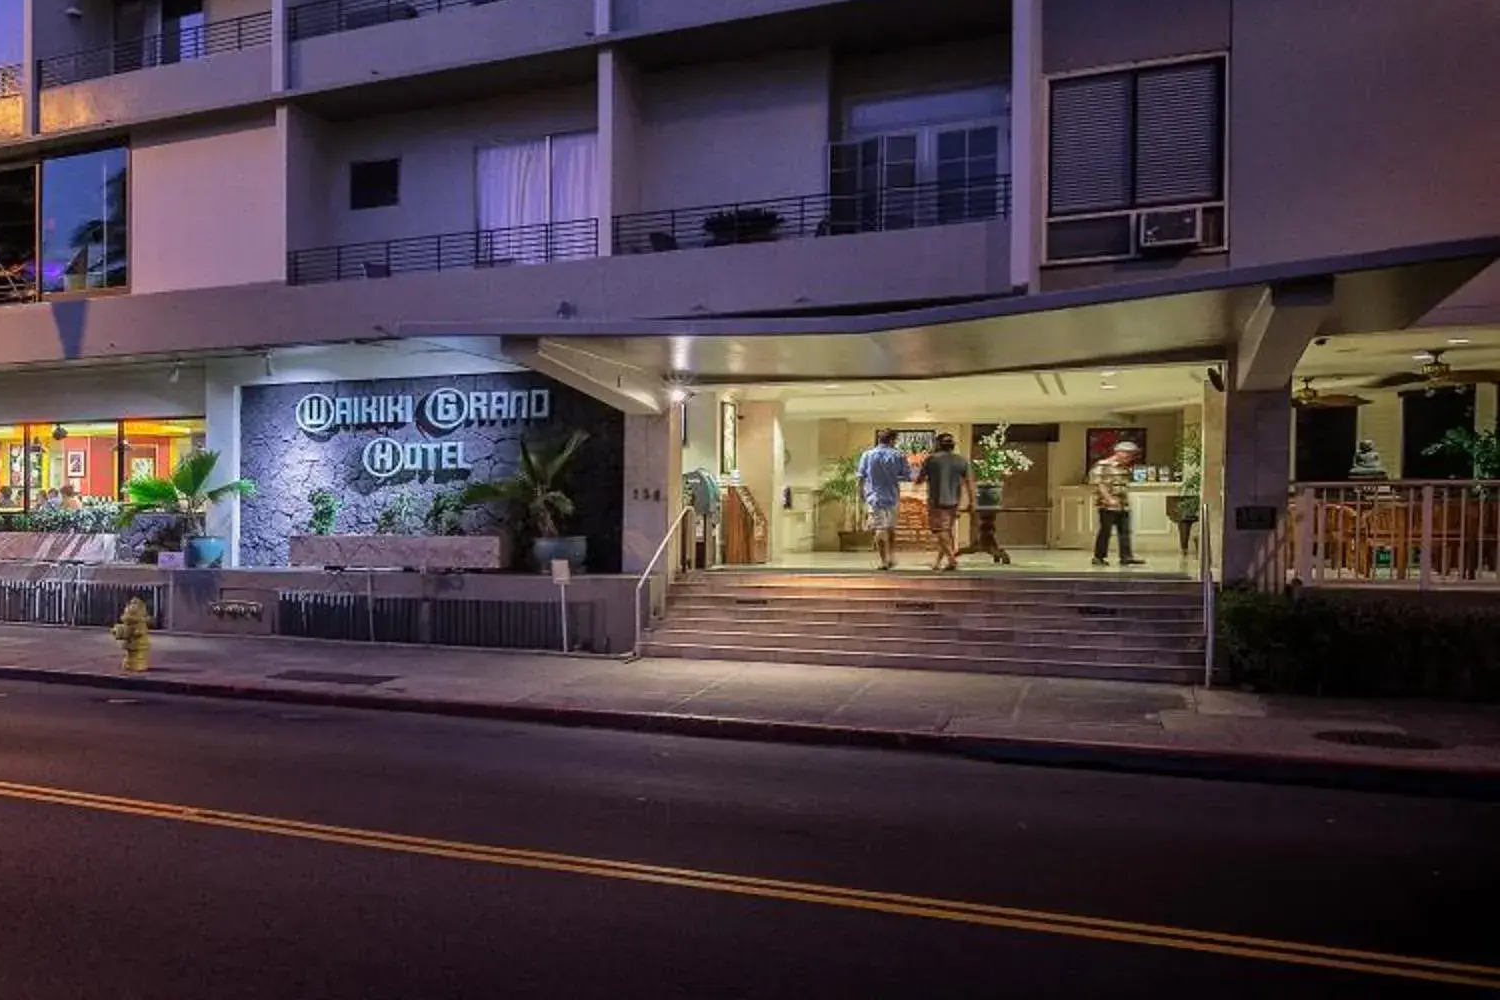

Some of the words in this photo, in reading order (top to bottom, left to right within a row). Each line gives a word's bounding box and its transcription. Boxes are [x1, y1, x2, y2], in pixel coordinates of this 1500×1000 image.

[296, 394, 413, 431] WAIKIKI
[425, 388, 549, 428] GRAND
[363, 438, 471, 476] HOTEL
